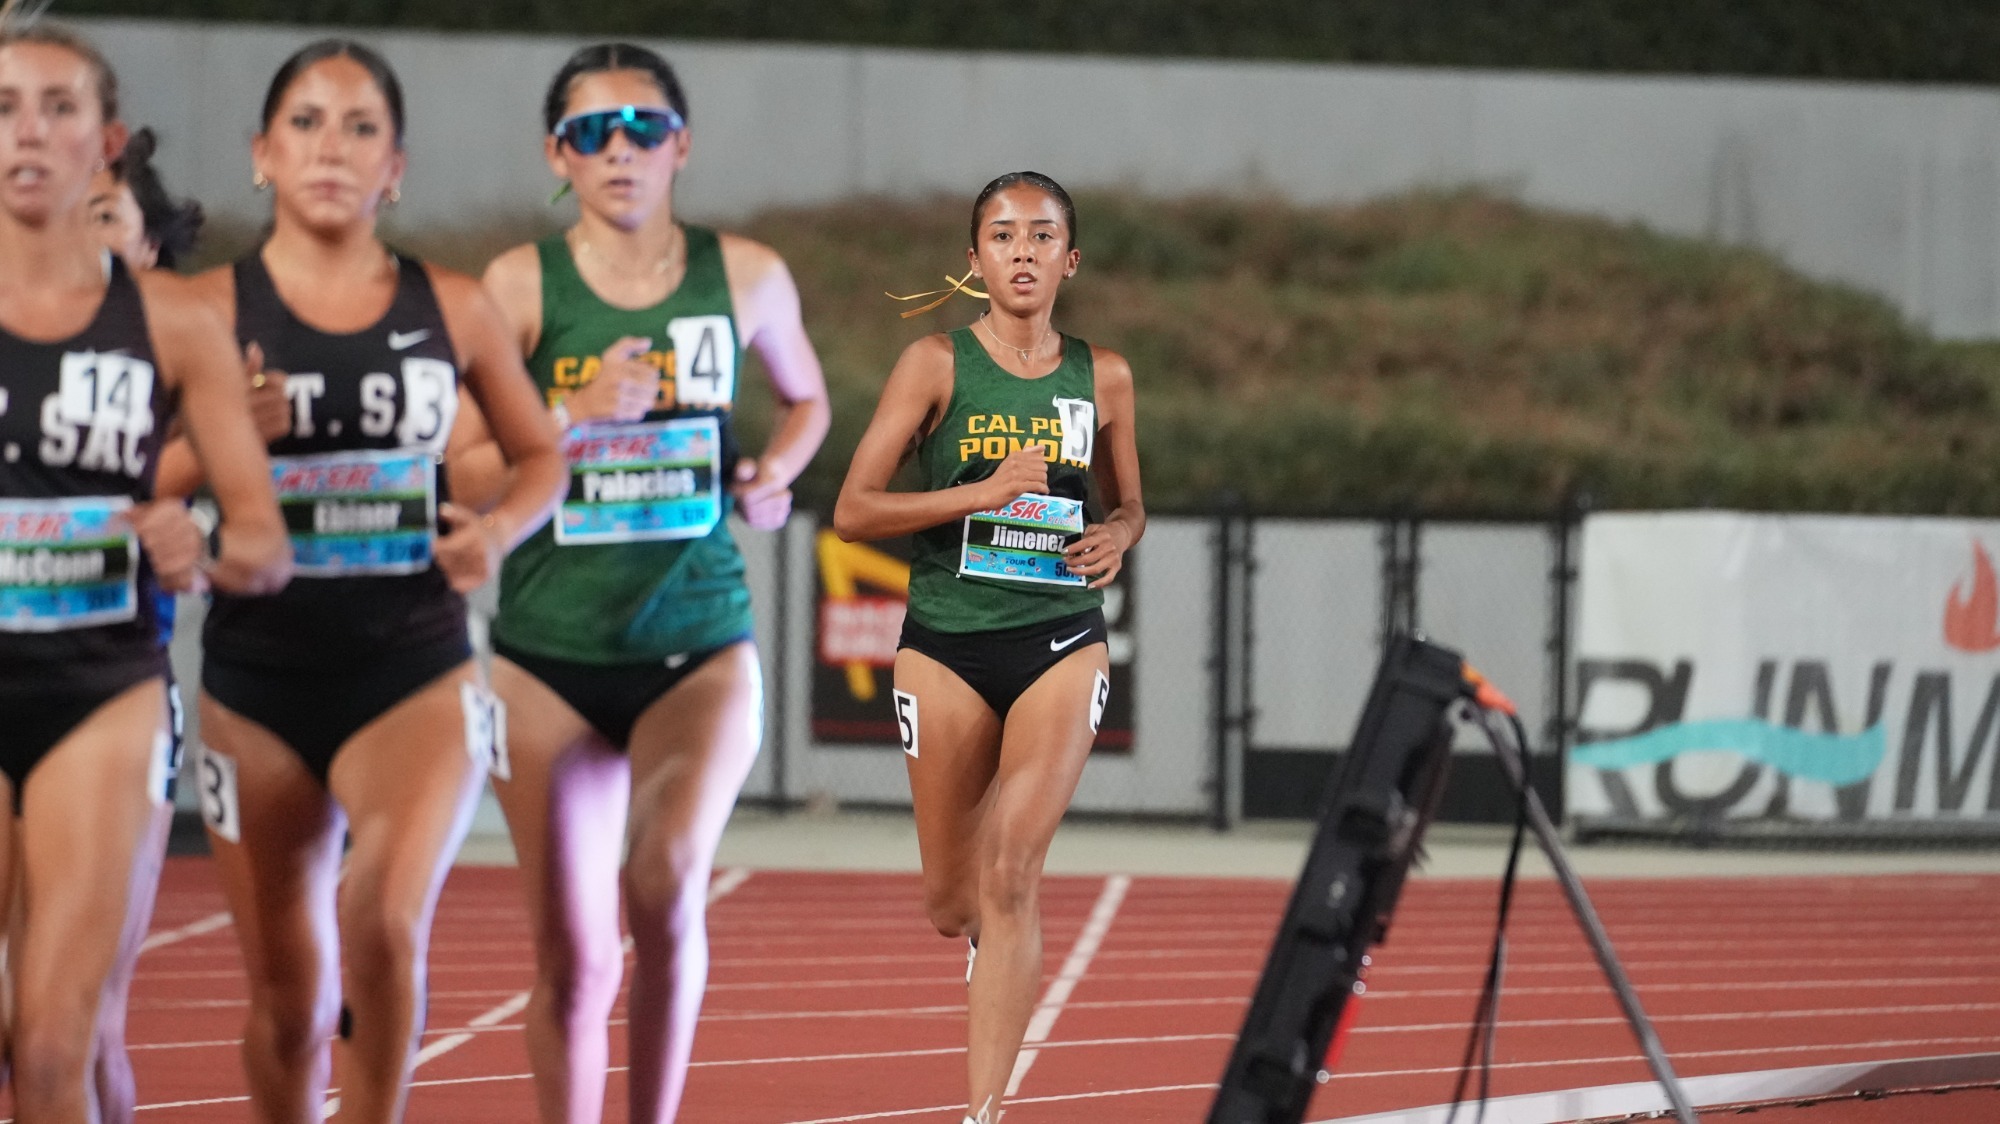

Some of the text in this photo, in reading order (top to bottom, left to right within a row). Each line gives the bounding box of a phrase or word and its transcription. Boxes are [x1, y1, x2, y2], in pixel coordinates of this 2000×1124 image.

[553, 355, 600, 387] CA
[690, 326, 722, 393] 4
[82, 366, 132, 417] 14
[417, 370, 443, 441] 3
[968, 414, 1064, 437] CAL PO
[1068, 403, 1088, 458] 5
[959, 436, 1089, 472] POMO
[1009, 500, 1049, 521] SAC
[990, 525, 1066, 554] Jimenez
[897, 695, 913, 751] 5
[203, 757, 224, 824] 3
